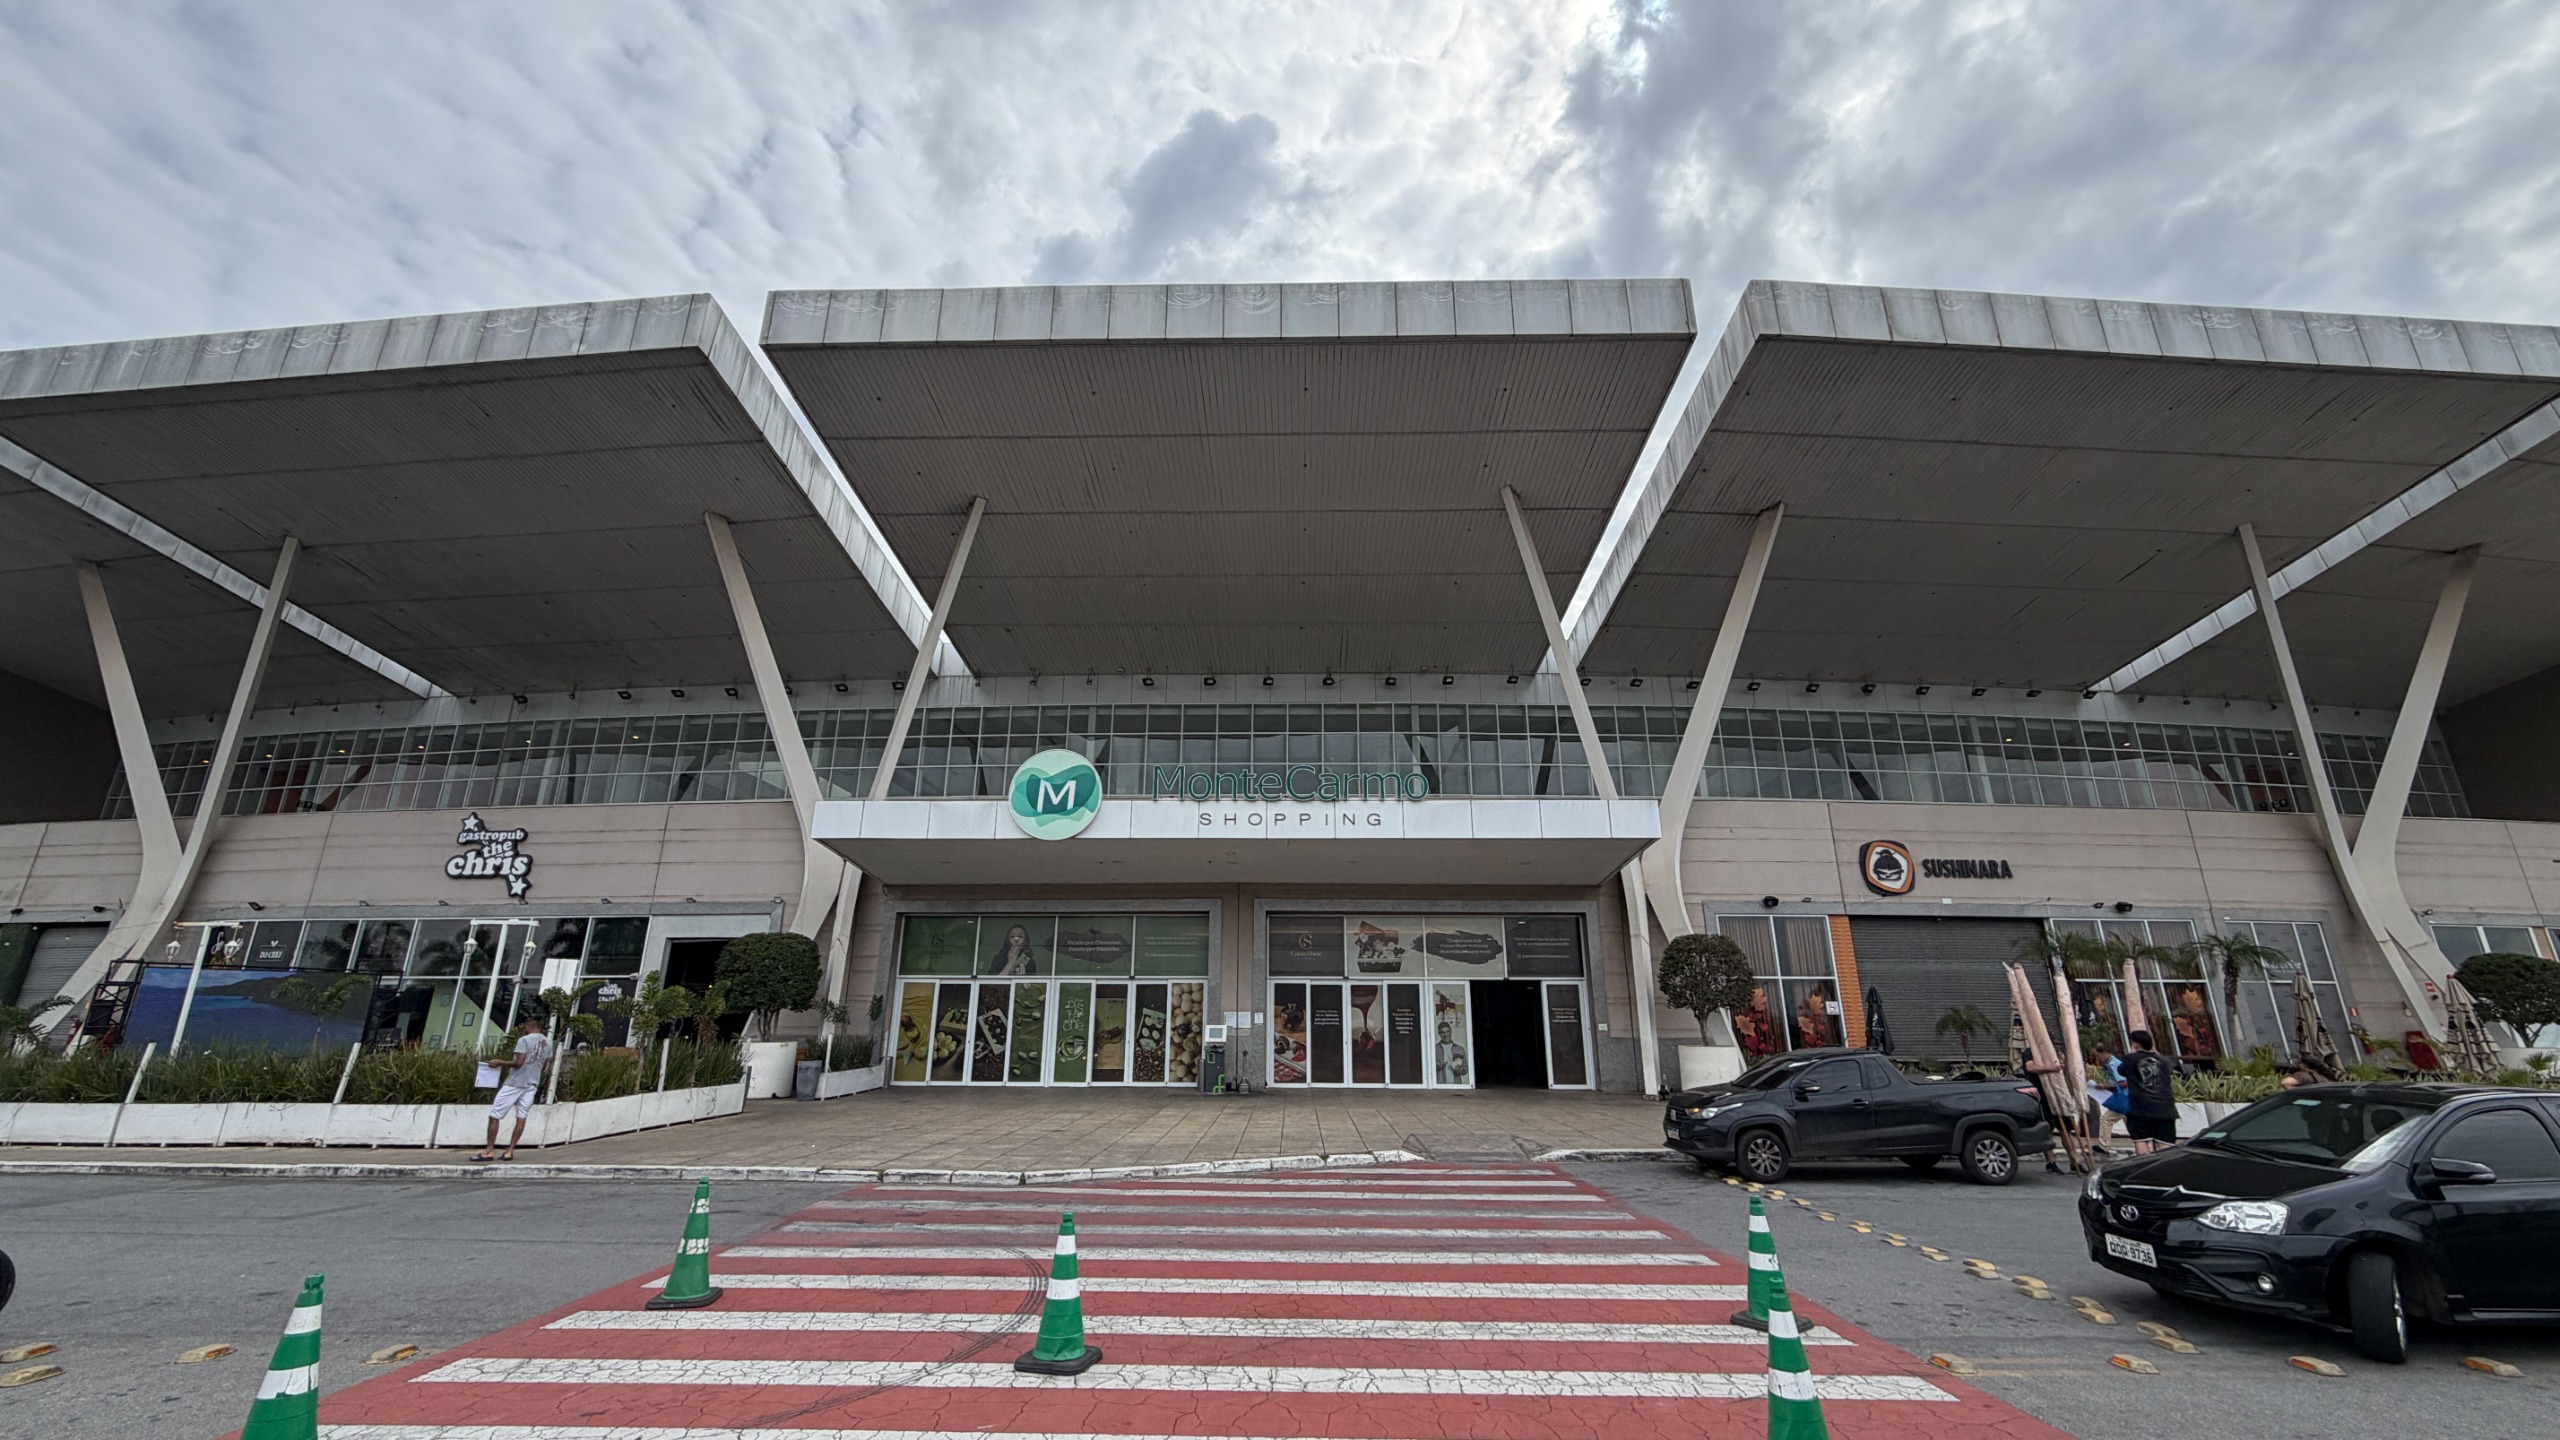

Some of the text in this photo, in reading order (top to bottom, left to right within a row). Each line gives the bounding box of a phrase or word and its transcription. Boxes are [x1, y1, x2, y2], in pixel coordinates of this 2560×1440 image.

[1153, 764, 1429, 802] MonteCarmo
[1036, 779, 1077, 814] M
[1199, 813, 1382, 827] SHOPPING
[458, 829, 524, 843] gastropub
[482, 841, 513, 858] the
[447, 851, 529, 876] chris
[1922, 859, 2013, 879] SUSHINARA
